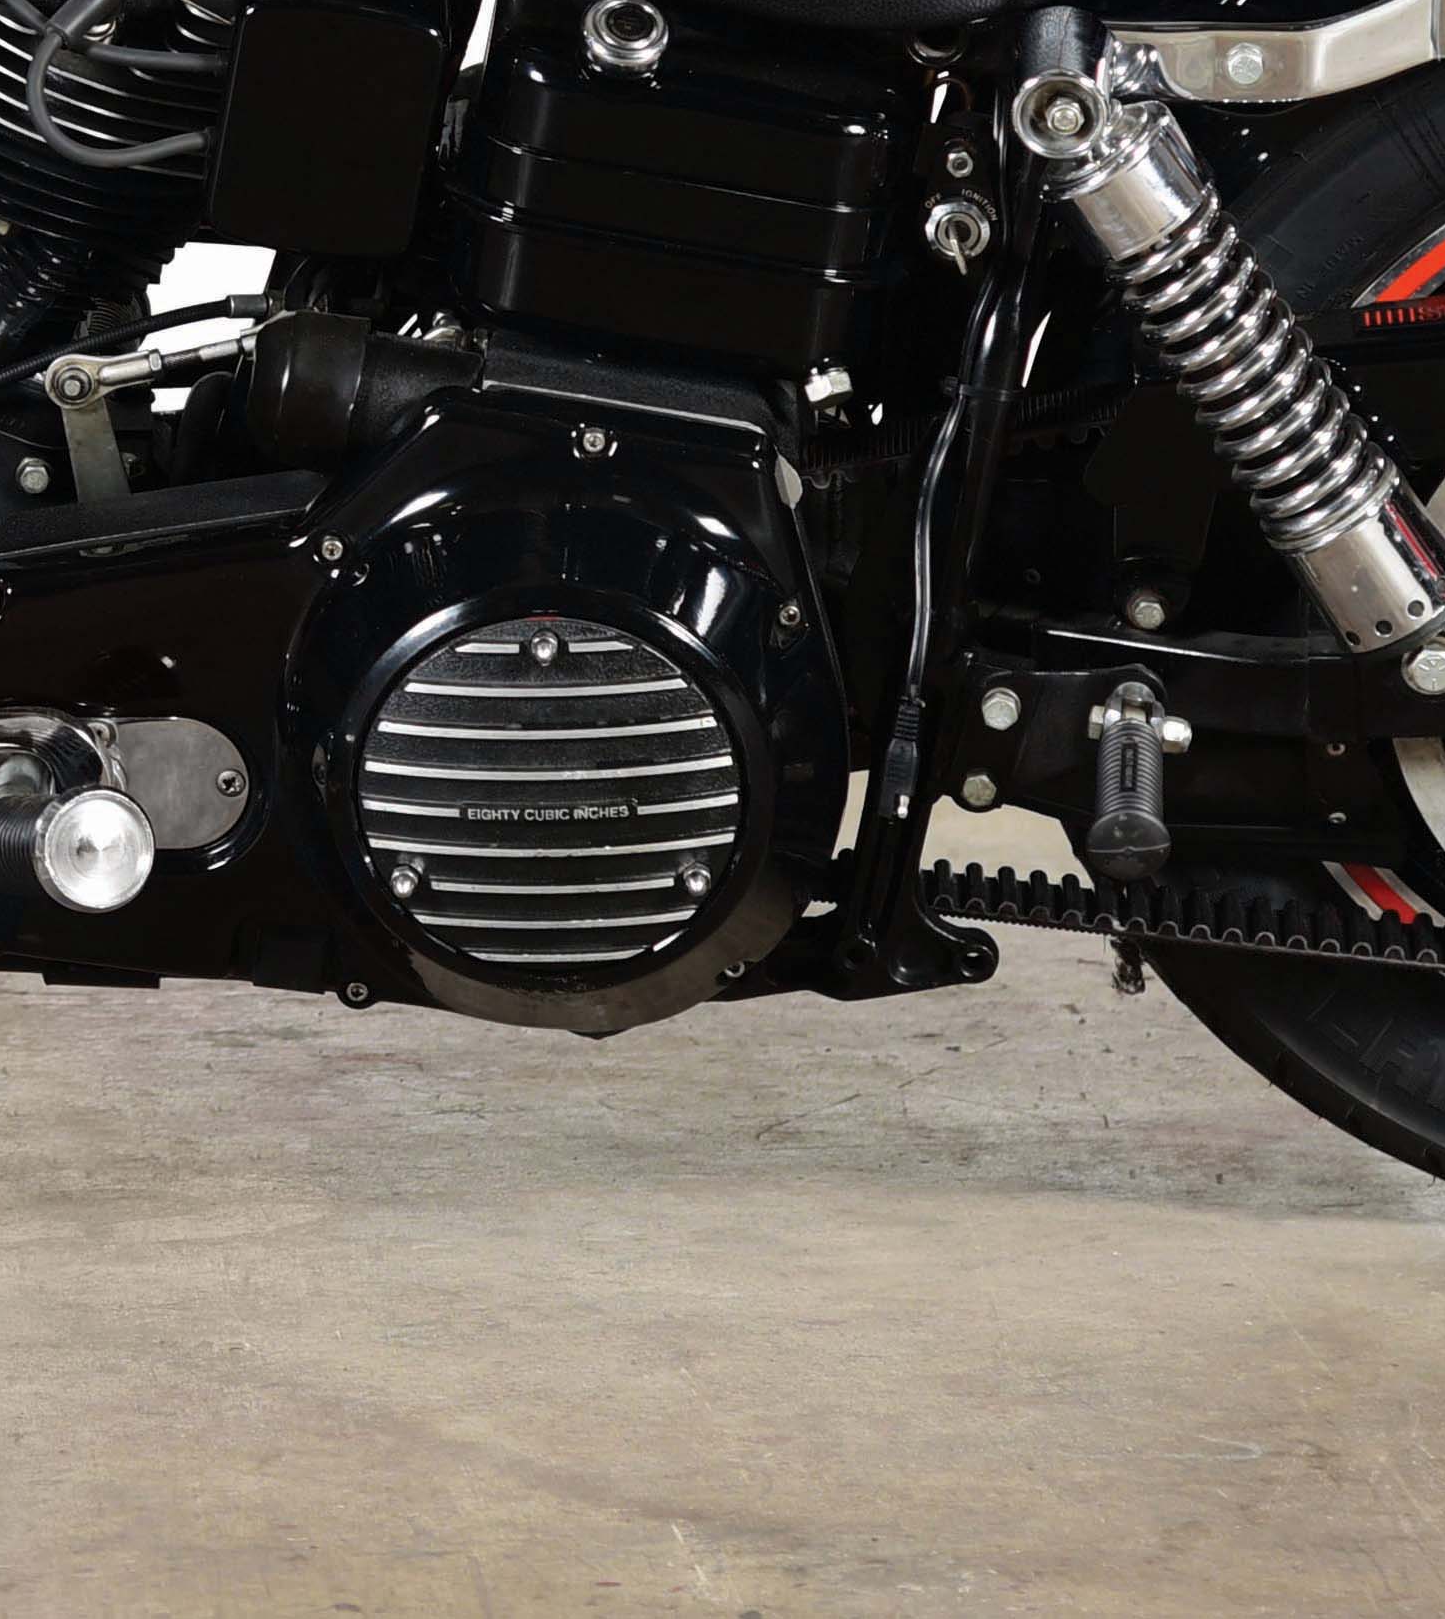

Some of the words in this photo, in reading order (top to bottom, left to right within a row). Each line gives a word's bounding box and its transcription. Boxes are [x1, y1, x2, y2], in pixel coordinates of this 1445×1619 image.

[961, 188, 999, 221] IGNITION
[467, 807, 520, 821] EIGHTY
[523, 808, 570, 821] CUBIC
[573, 805, 630, 820] INCHES
